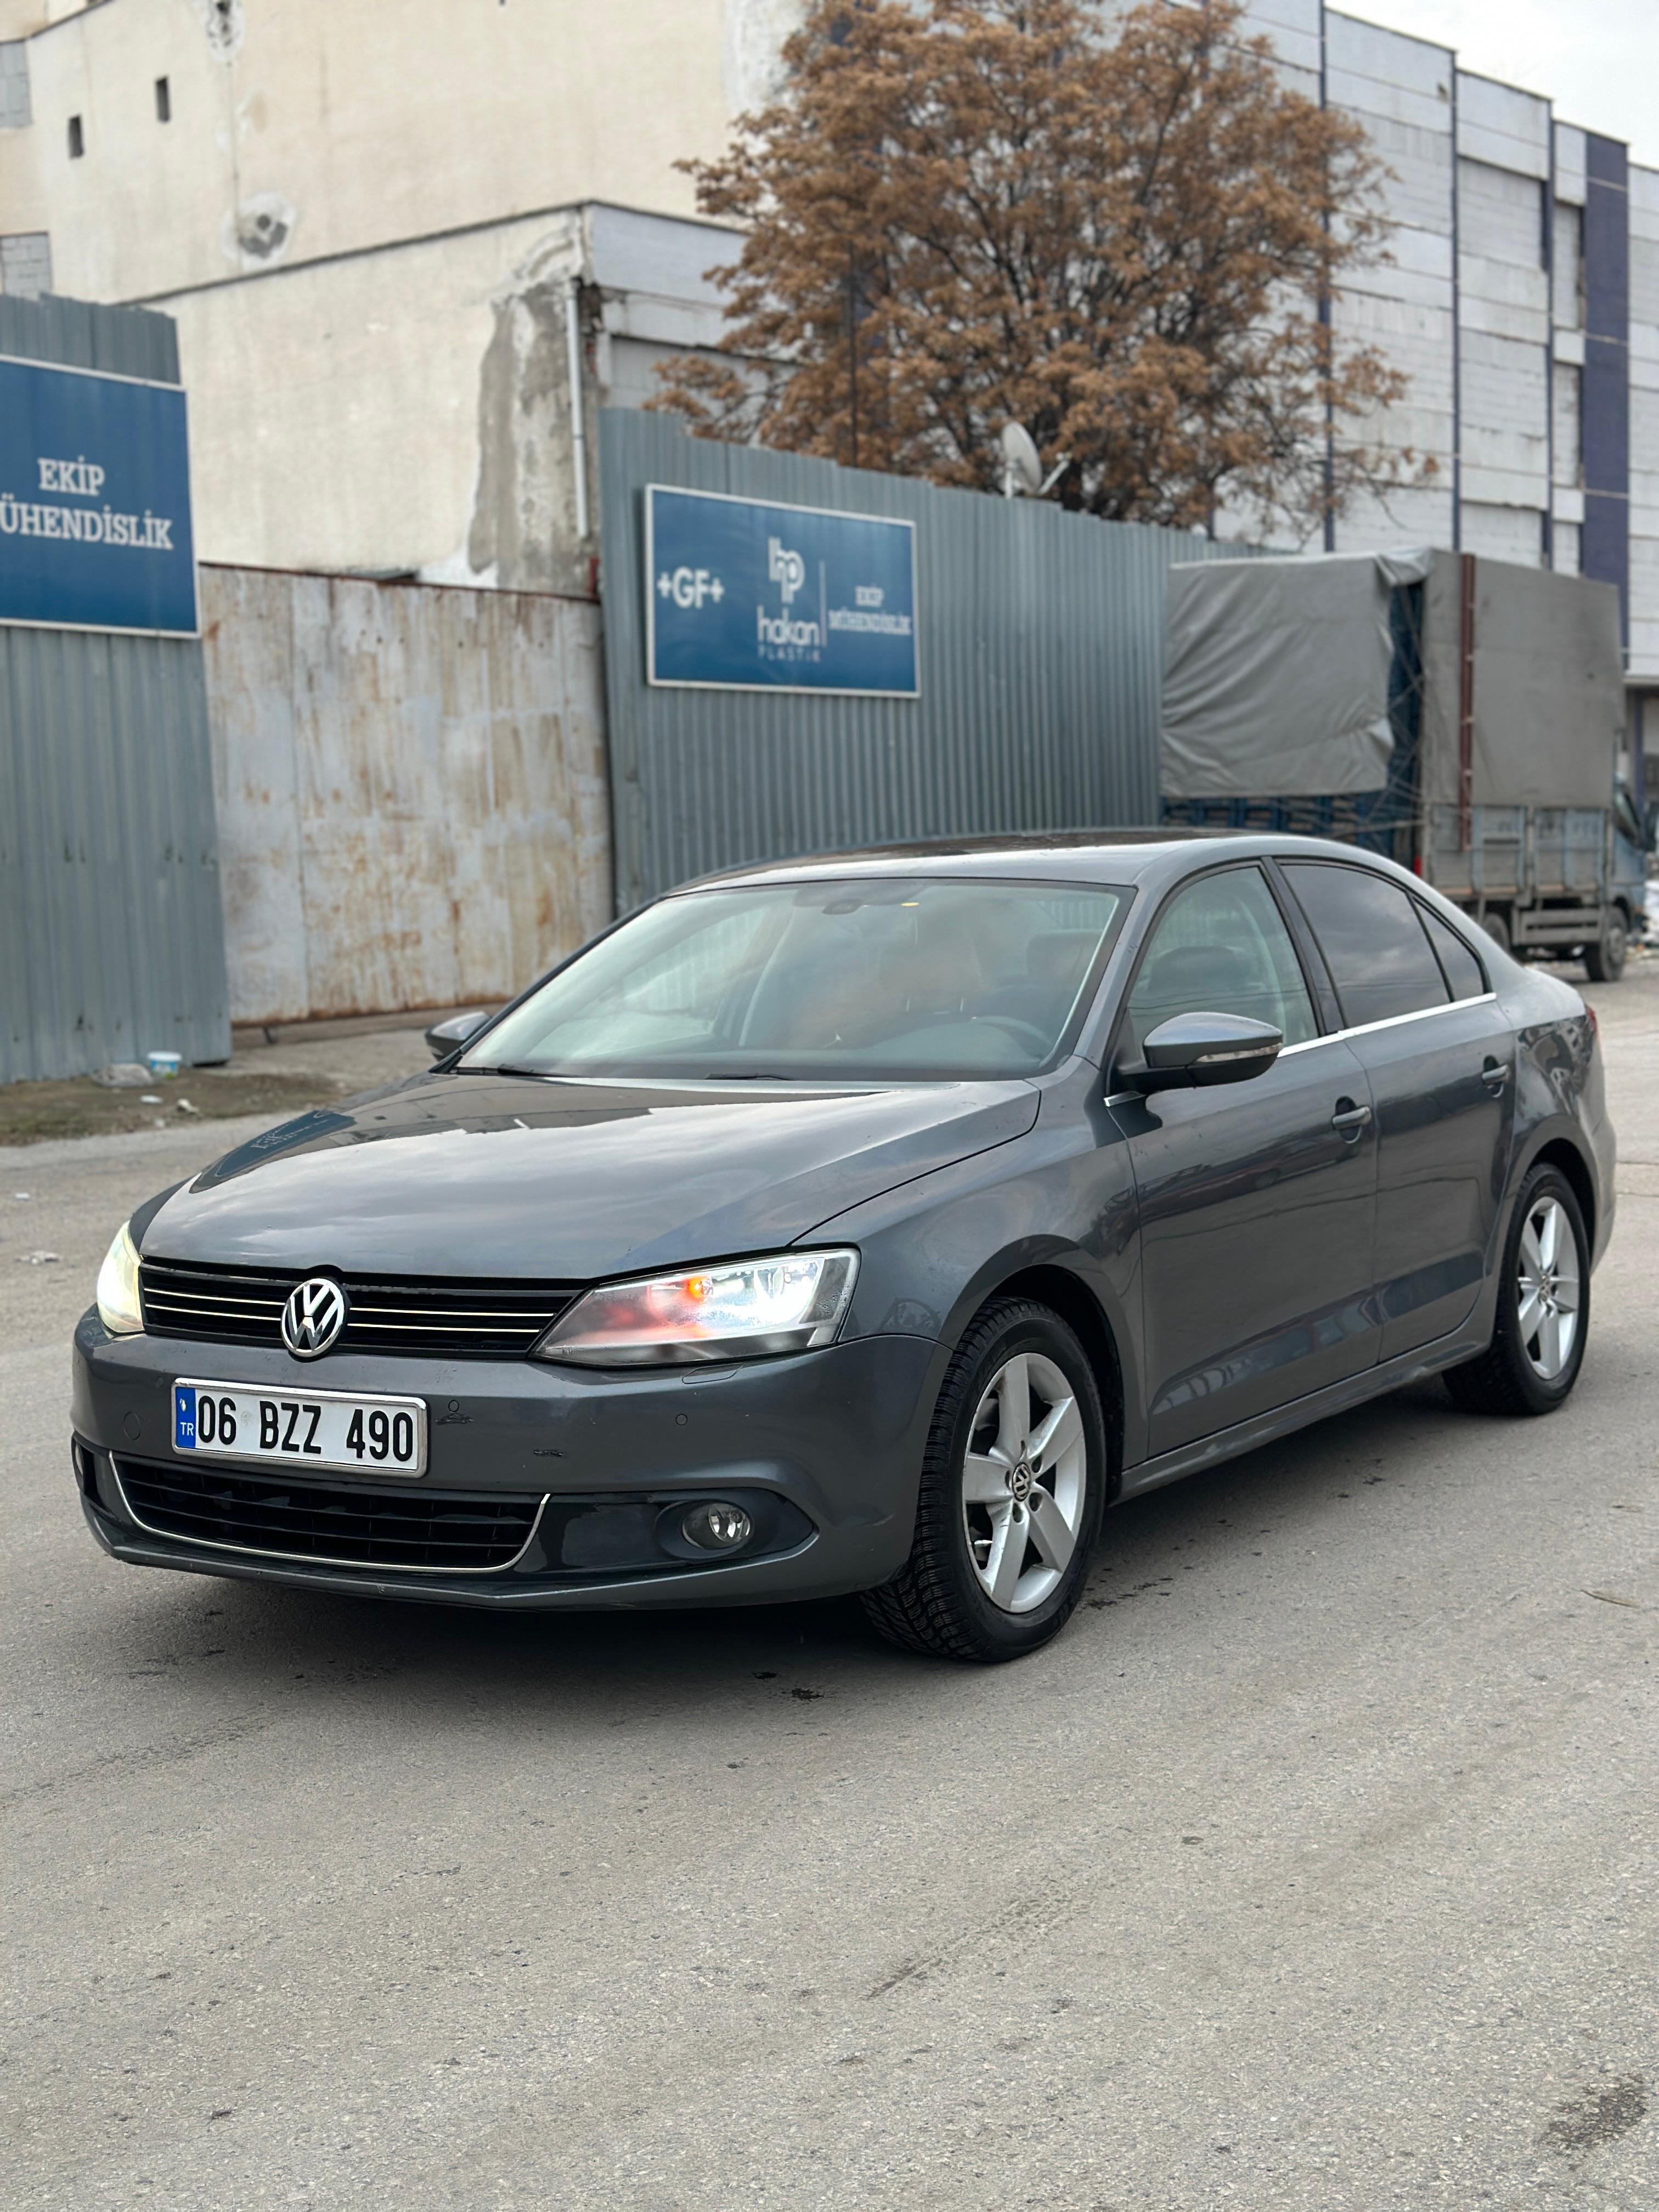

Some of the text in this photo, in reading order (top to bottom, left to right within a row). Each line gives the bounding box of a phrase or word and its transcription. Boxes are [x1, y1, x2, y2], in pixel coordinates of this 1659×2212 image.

[38, 455, 105, 496] EKİP
[180, 1395, 413, 1462] TR 06 BZZ 490
